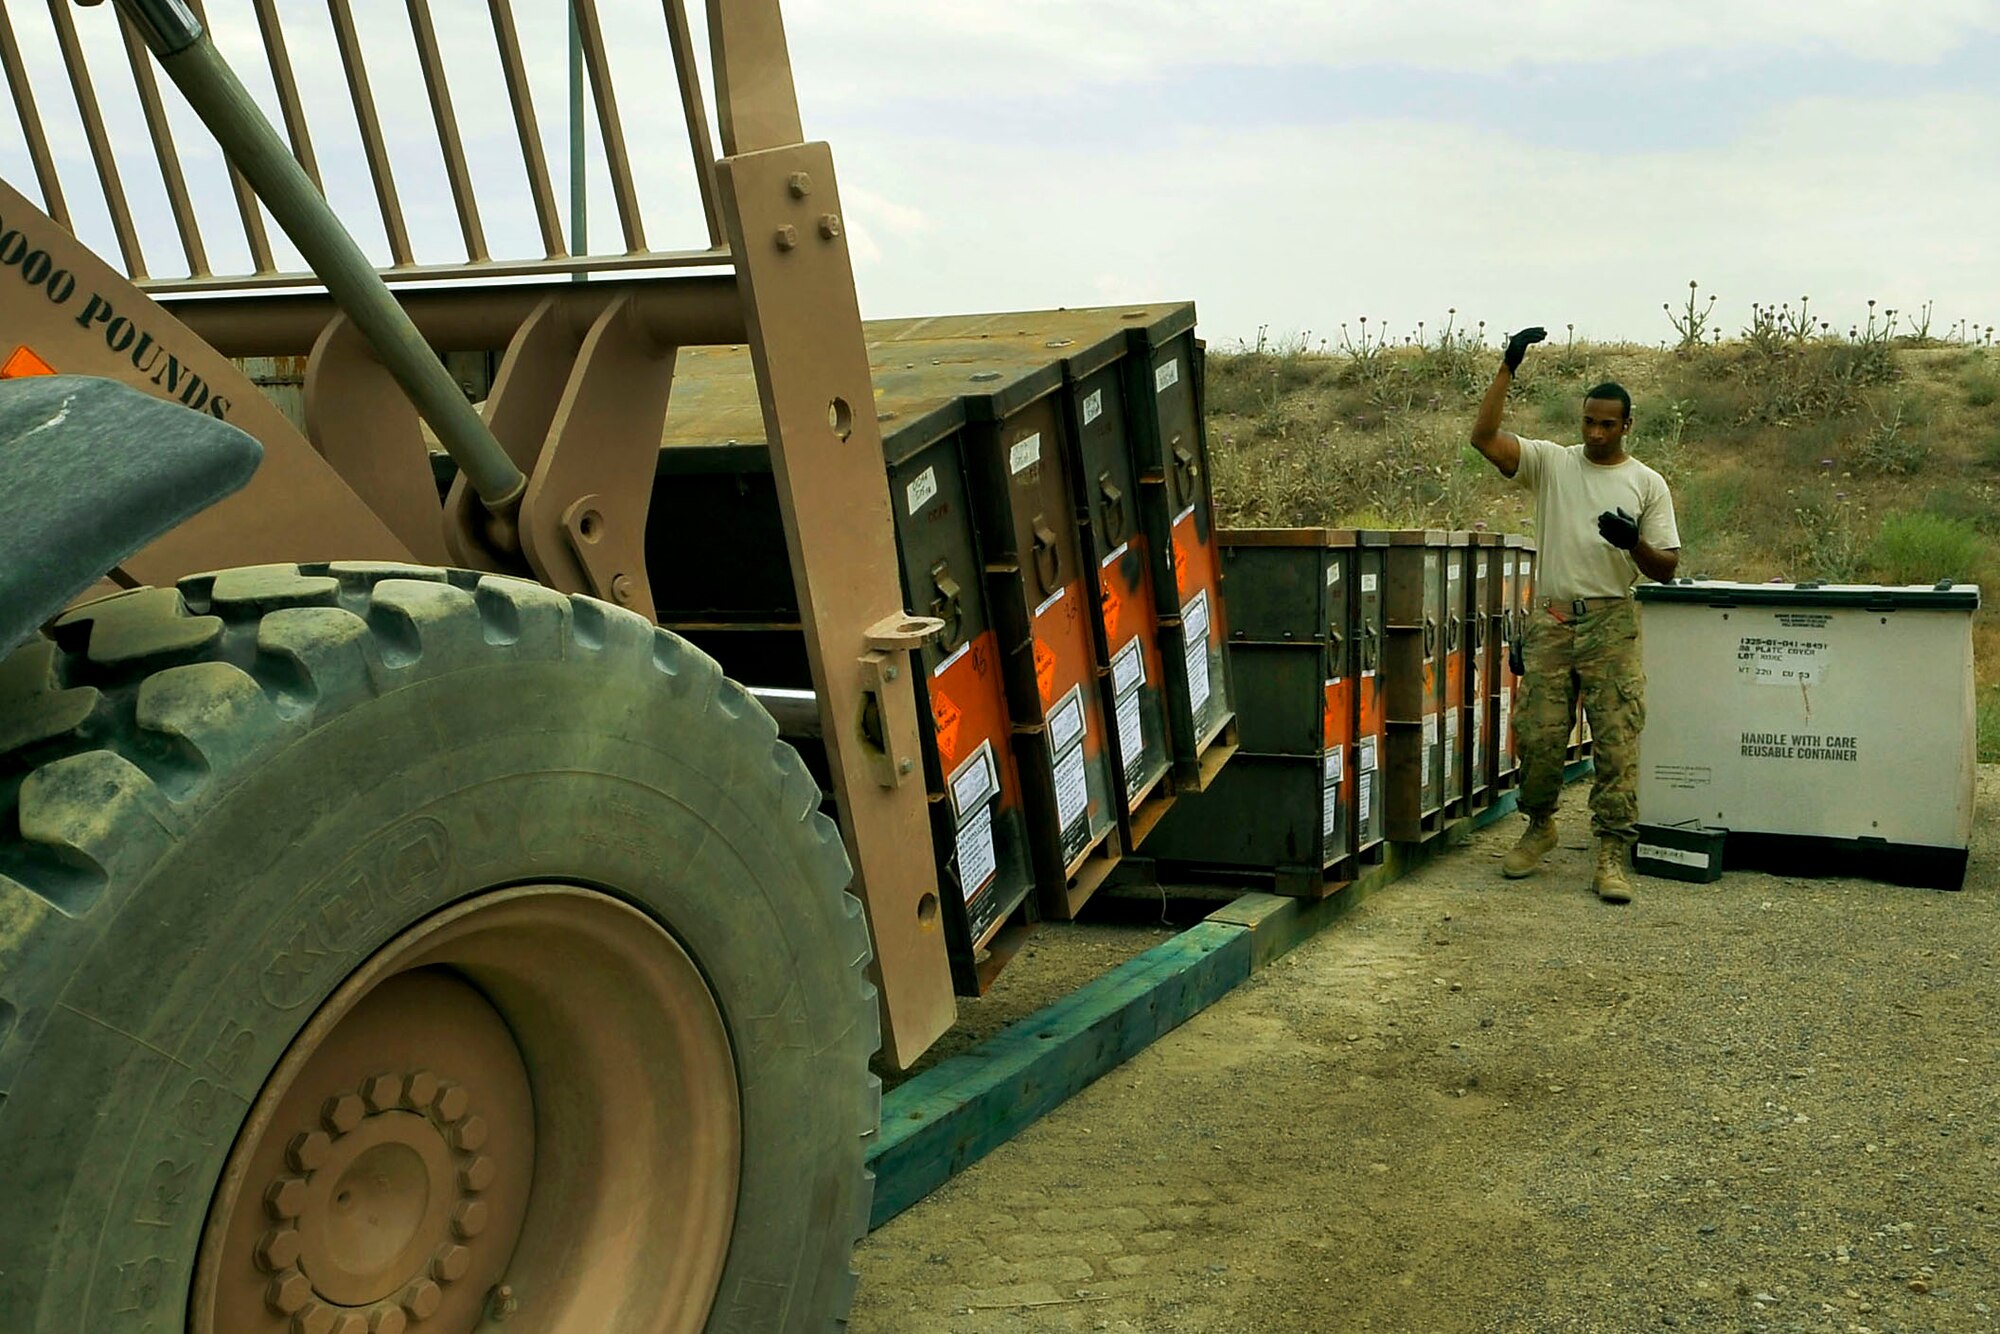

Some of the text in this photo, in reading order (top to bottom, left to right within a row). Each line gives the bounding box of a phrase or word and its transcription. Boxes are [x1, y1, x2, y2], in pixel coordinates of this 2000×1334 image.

[0, 213, 231, 420] 000 POUNDS
[1741, 732, 1858, 749] HANDLE WITH CARE
[1741, 745, 1858, 762] REUSABLE CONTAINER
